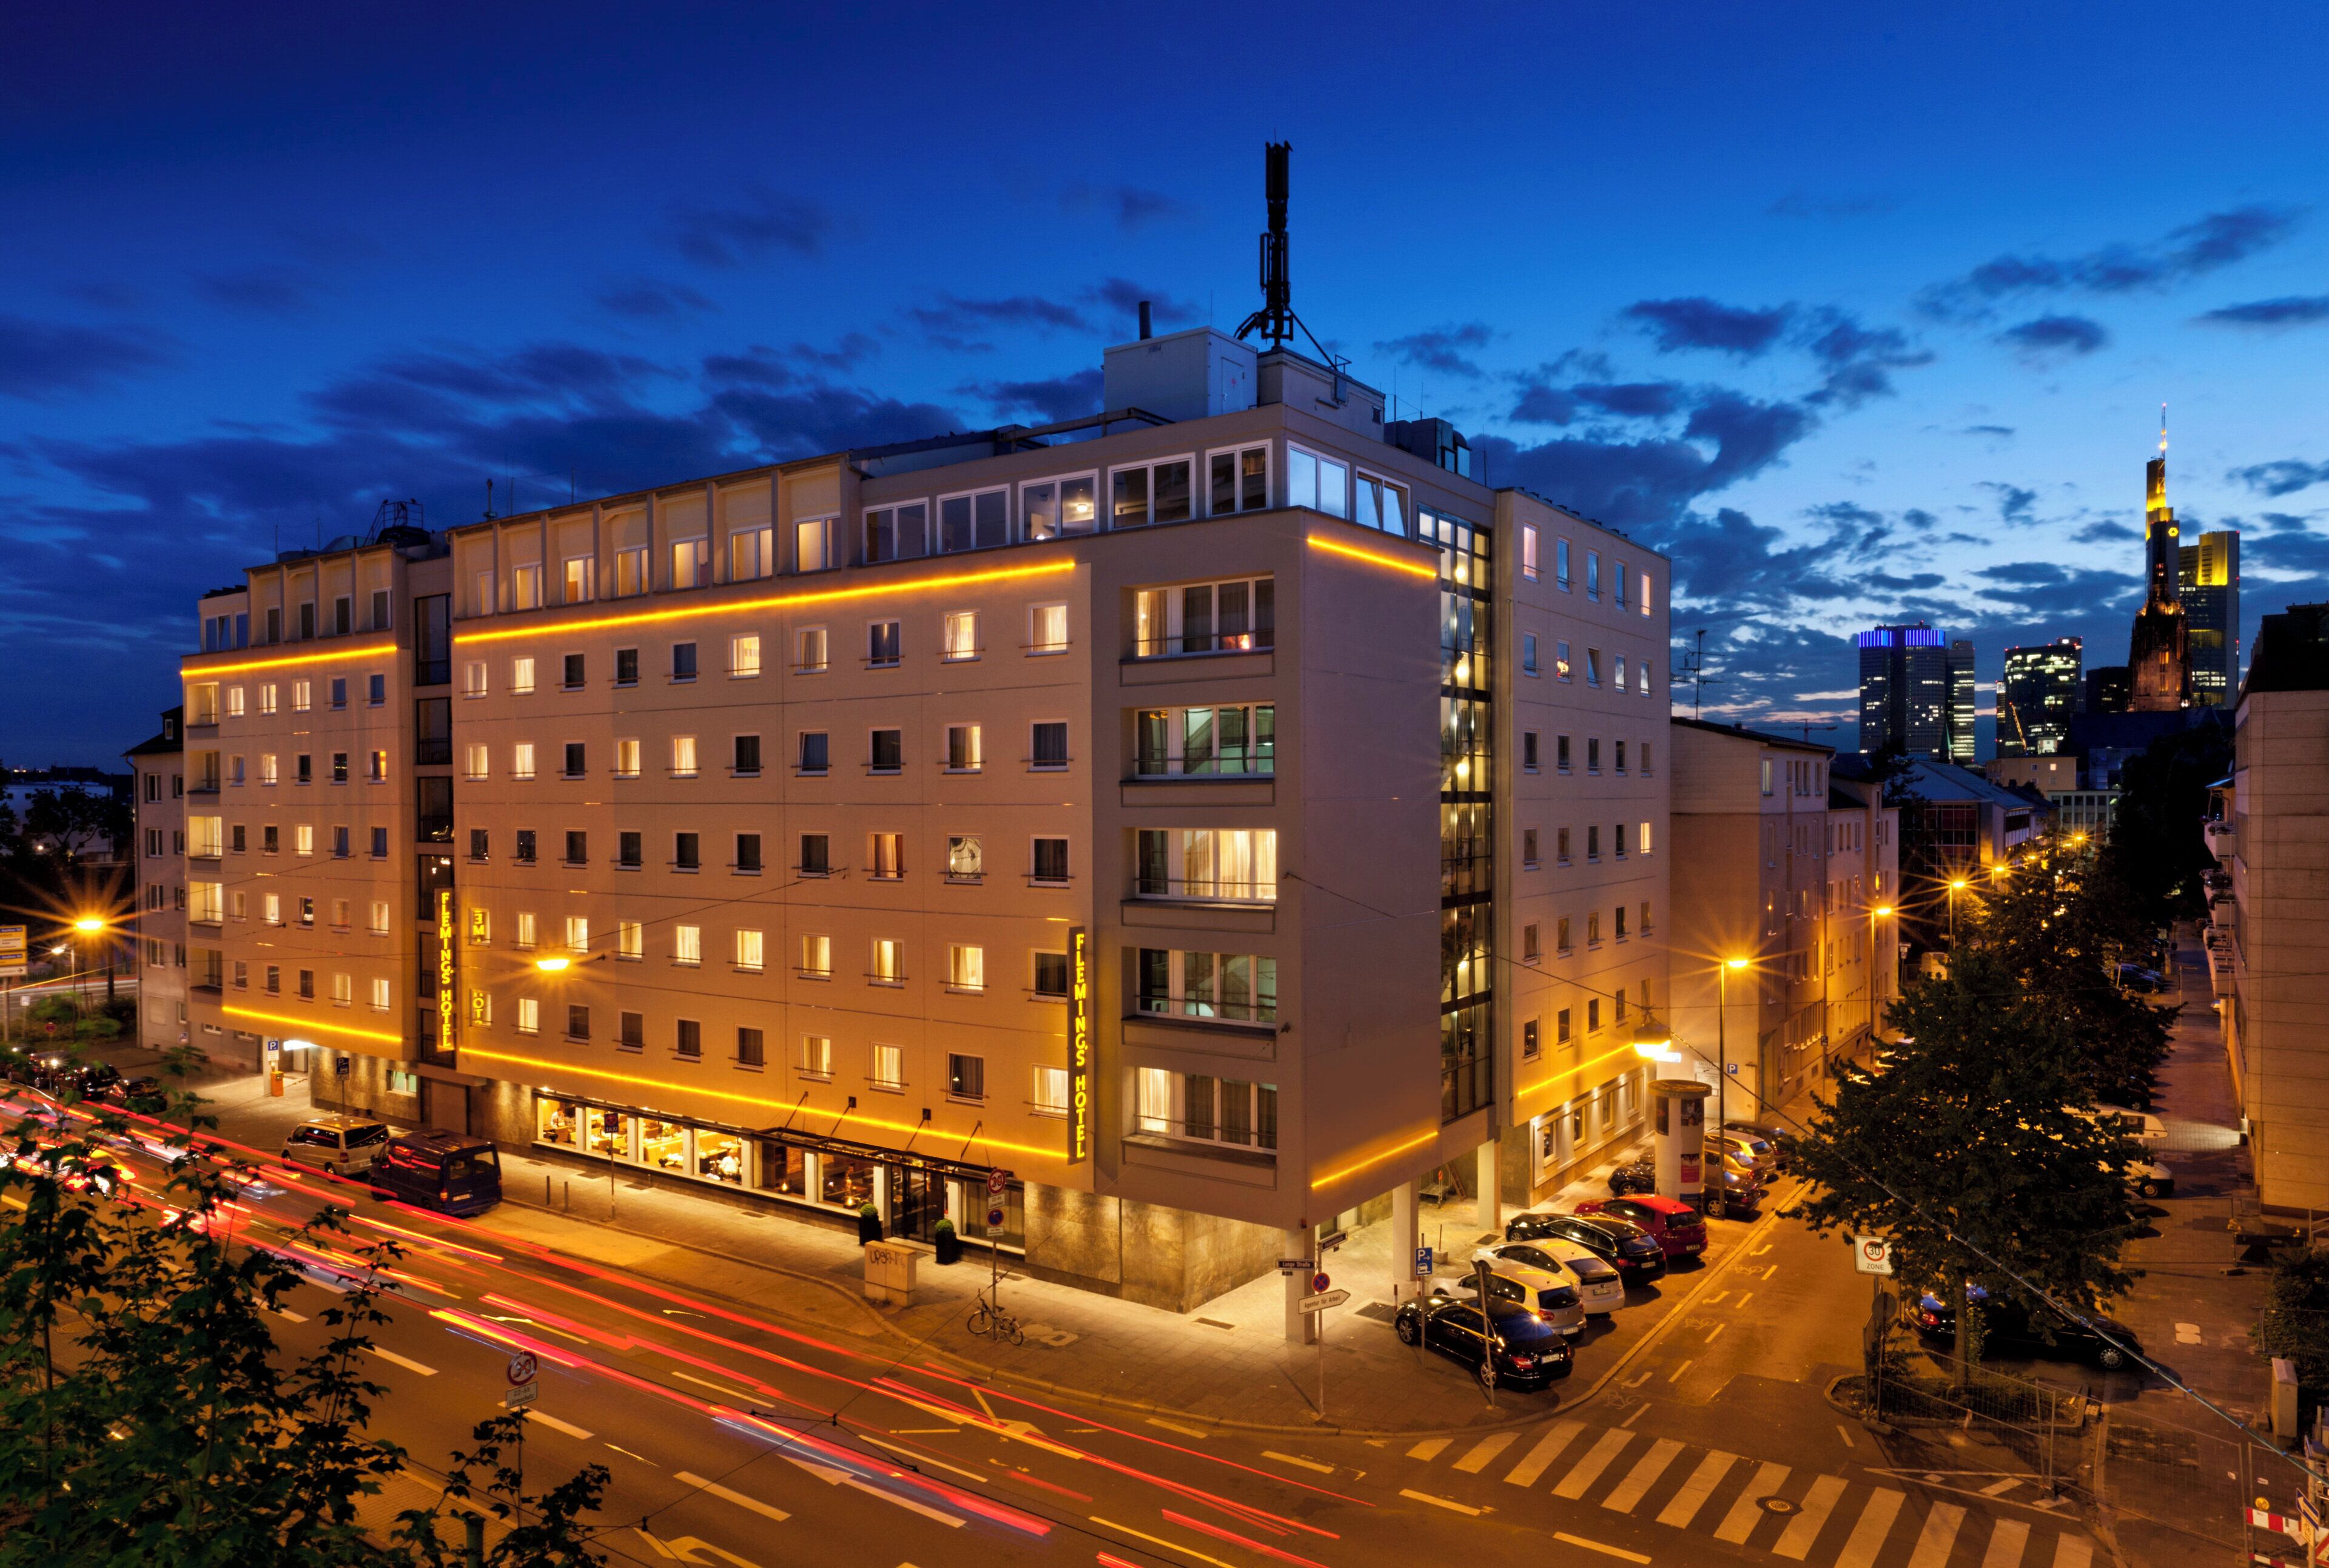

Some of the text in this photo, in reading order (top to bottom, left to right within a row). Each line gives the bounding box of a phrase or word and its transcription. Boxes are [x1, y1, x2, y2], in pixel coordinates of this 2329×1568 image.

[440, 892, 454, 1047] FLEMING'S HOTEL
[270, 1041, 276, 1050] P
[1074, 934, 1088, 1158] FLEMING'S HOTEL
[1417, 1250, 1425, 1261] P
[1869, 1245, 1880, 1256] 30
[1305, 1300, 1319, 1309] Agentur
[1329, 1294, 1341, 1303] Arbeit
